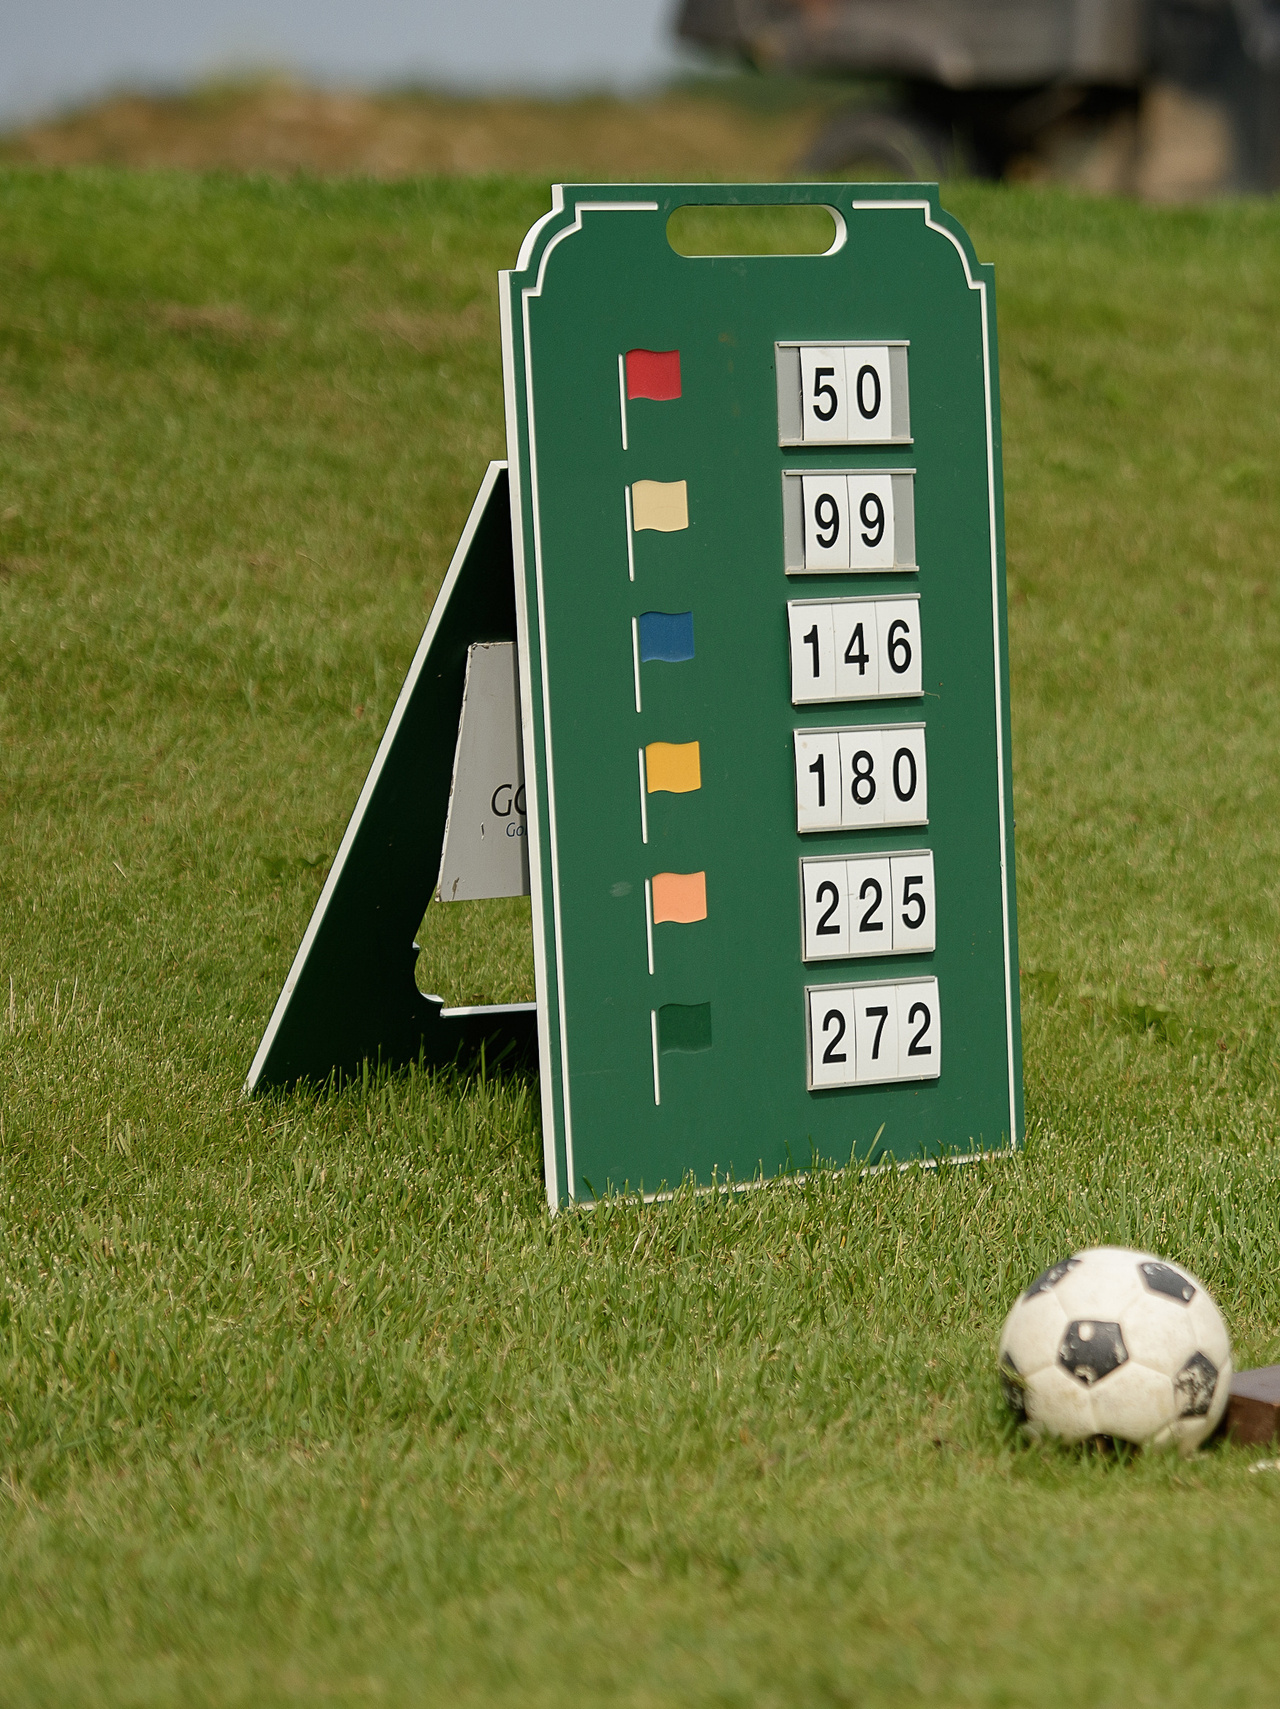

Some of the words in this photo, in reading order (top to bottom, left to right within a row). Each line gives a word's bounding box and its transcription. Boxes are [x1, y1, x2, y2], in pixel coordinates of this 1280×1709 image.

[813, 364, 882, 421] 50
[814, 492, 885, 549] 99
[803, 619, 912, 678] 146
[808, 747, 917, 807] 180
[815, 875, 926, 936] 225
[822, 1001, 932, 1064] 272
